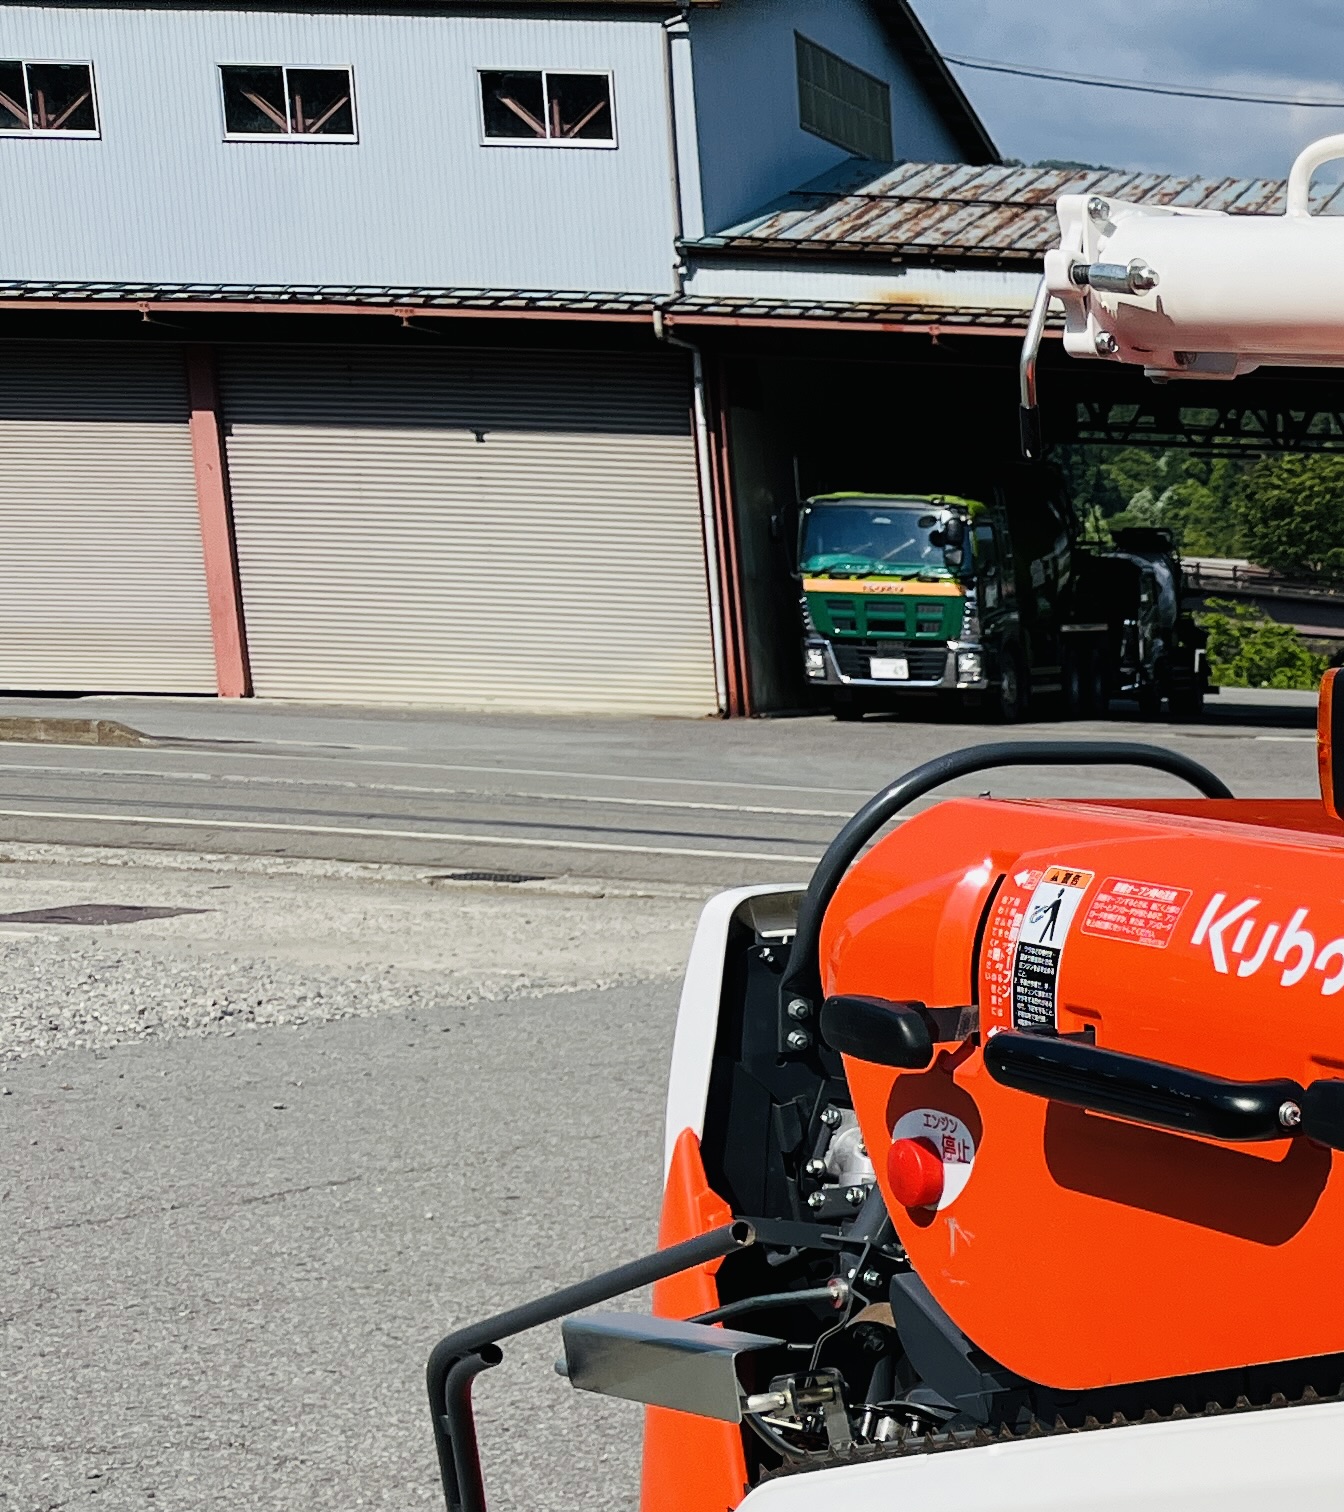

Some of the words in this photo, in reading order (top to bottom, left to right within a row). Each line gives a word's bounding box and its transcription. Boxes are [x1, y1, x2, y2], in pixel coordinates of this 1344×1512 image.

[923, 1113, 958, 1133] エンジン
[941, 1133, 971, 1165] 停止
